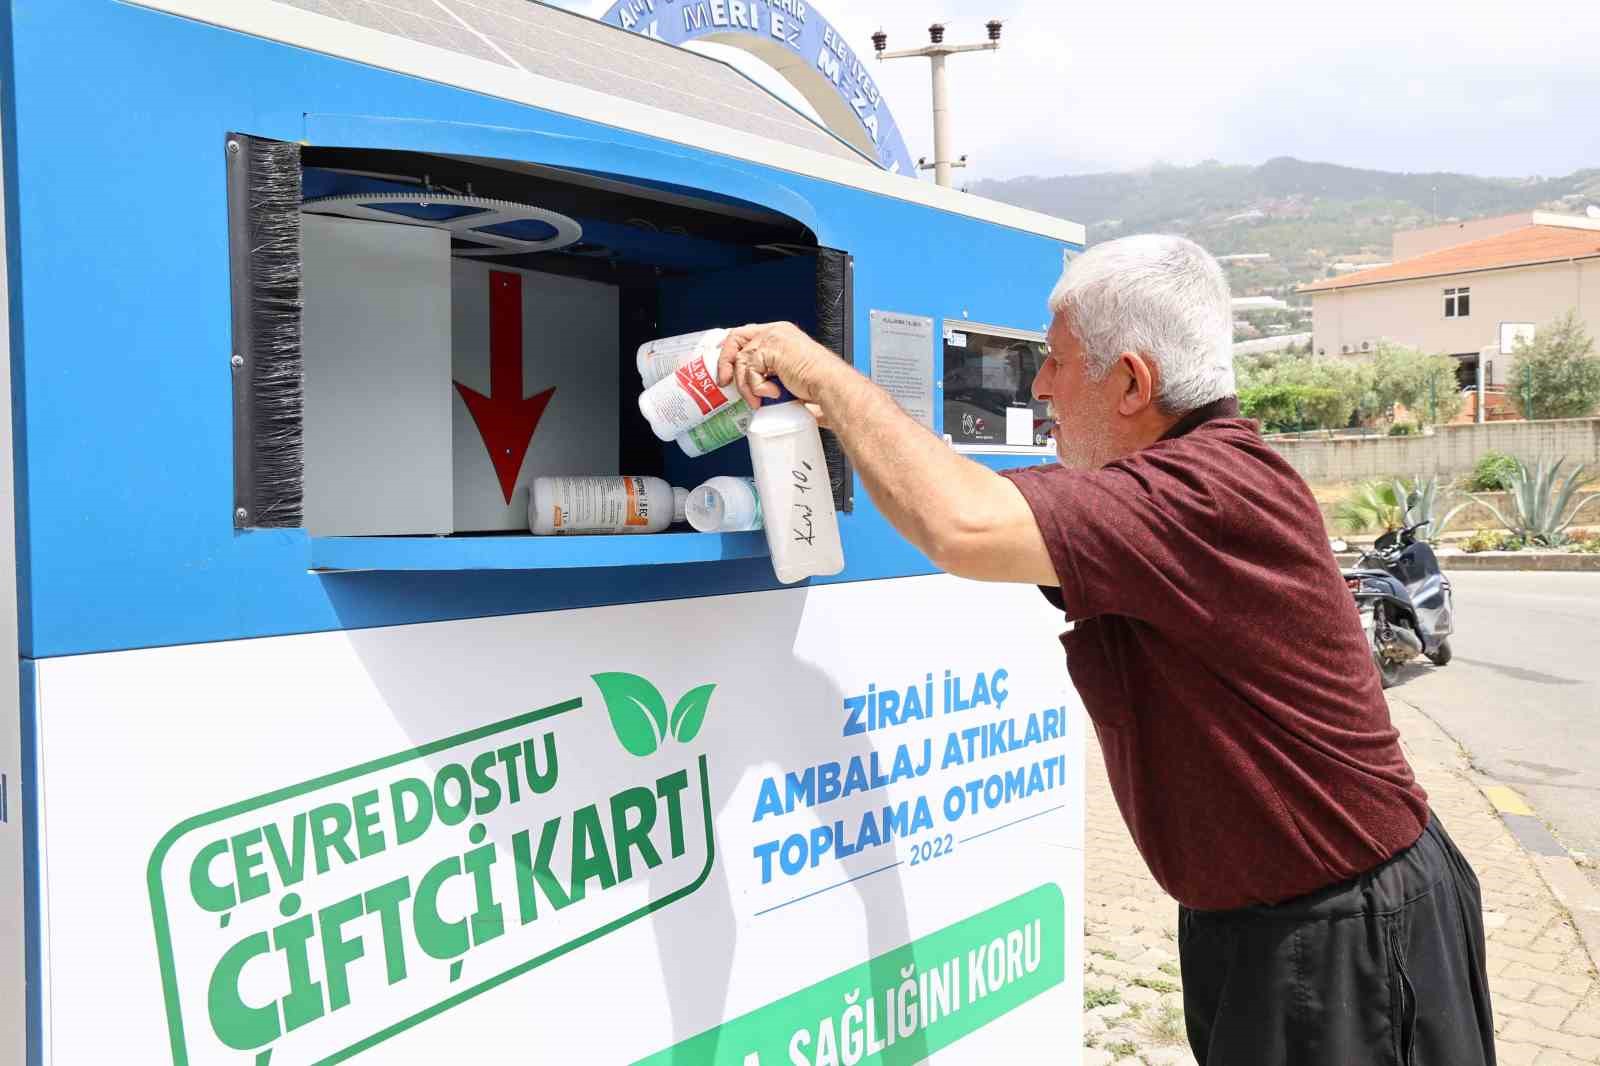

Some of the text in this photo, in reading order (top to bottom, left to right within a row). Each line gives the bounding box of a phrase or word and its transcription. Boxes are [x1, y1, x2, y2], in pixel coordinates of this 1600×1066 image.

[752, 706, 1067, 823] AMBALAJ ATIKLARI
[842, 668, 1009, 737] ZİRAİ İLAÇ
[189, 731, 560, 929] ÇEVRE DOSTU
[752, 755, 1066, 885] TOPLAMA OTOMATI
[909, 834, 954, 867] 2022
[207, 768, 689, 1066] ÇİFTÇİ KART
[788, 918, 1042, 1066] SAĞLIĞINI KORU
